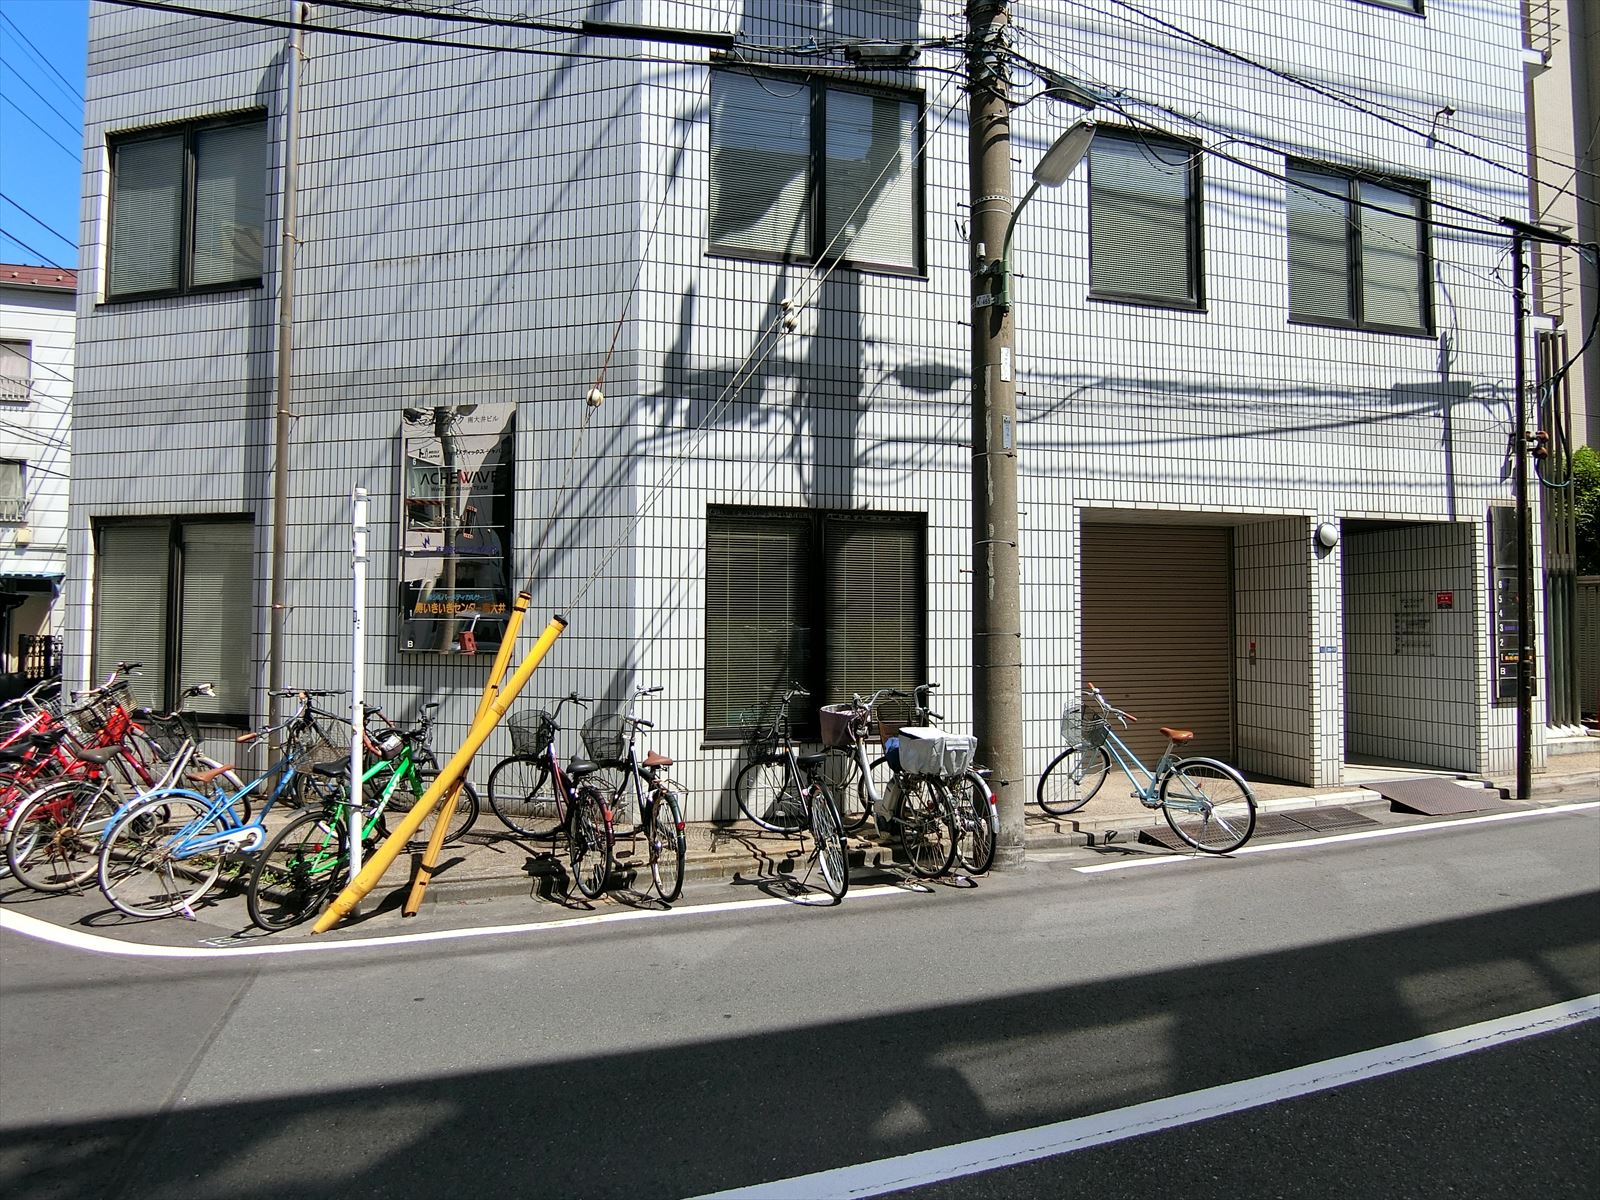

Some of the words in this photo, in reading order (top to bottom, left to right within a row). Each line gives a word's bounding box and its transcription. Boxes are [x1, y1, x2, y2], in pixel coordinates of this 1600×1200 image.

[411, 487, 416, 496] 5
[1498, 580, 1503, 589] 6
[1498, 595, 1503, 603] 5
[1498, 609, 1503, 618] 4
[1499, 623, 1504, 632] 3
[407, 640, 414, 648] B
[1499, 638, 1504, 647] 2
[1500, 667, 1506, 675] B
